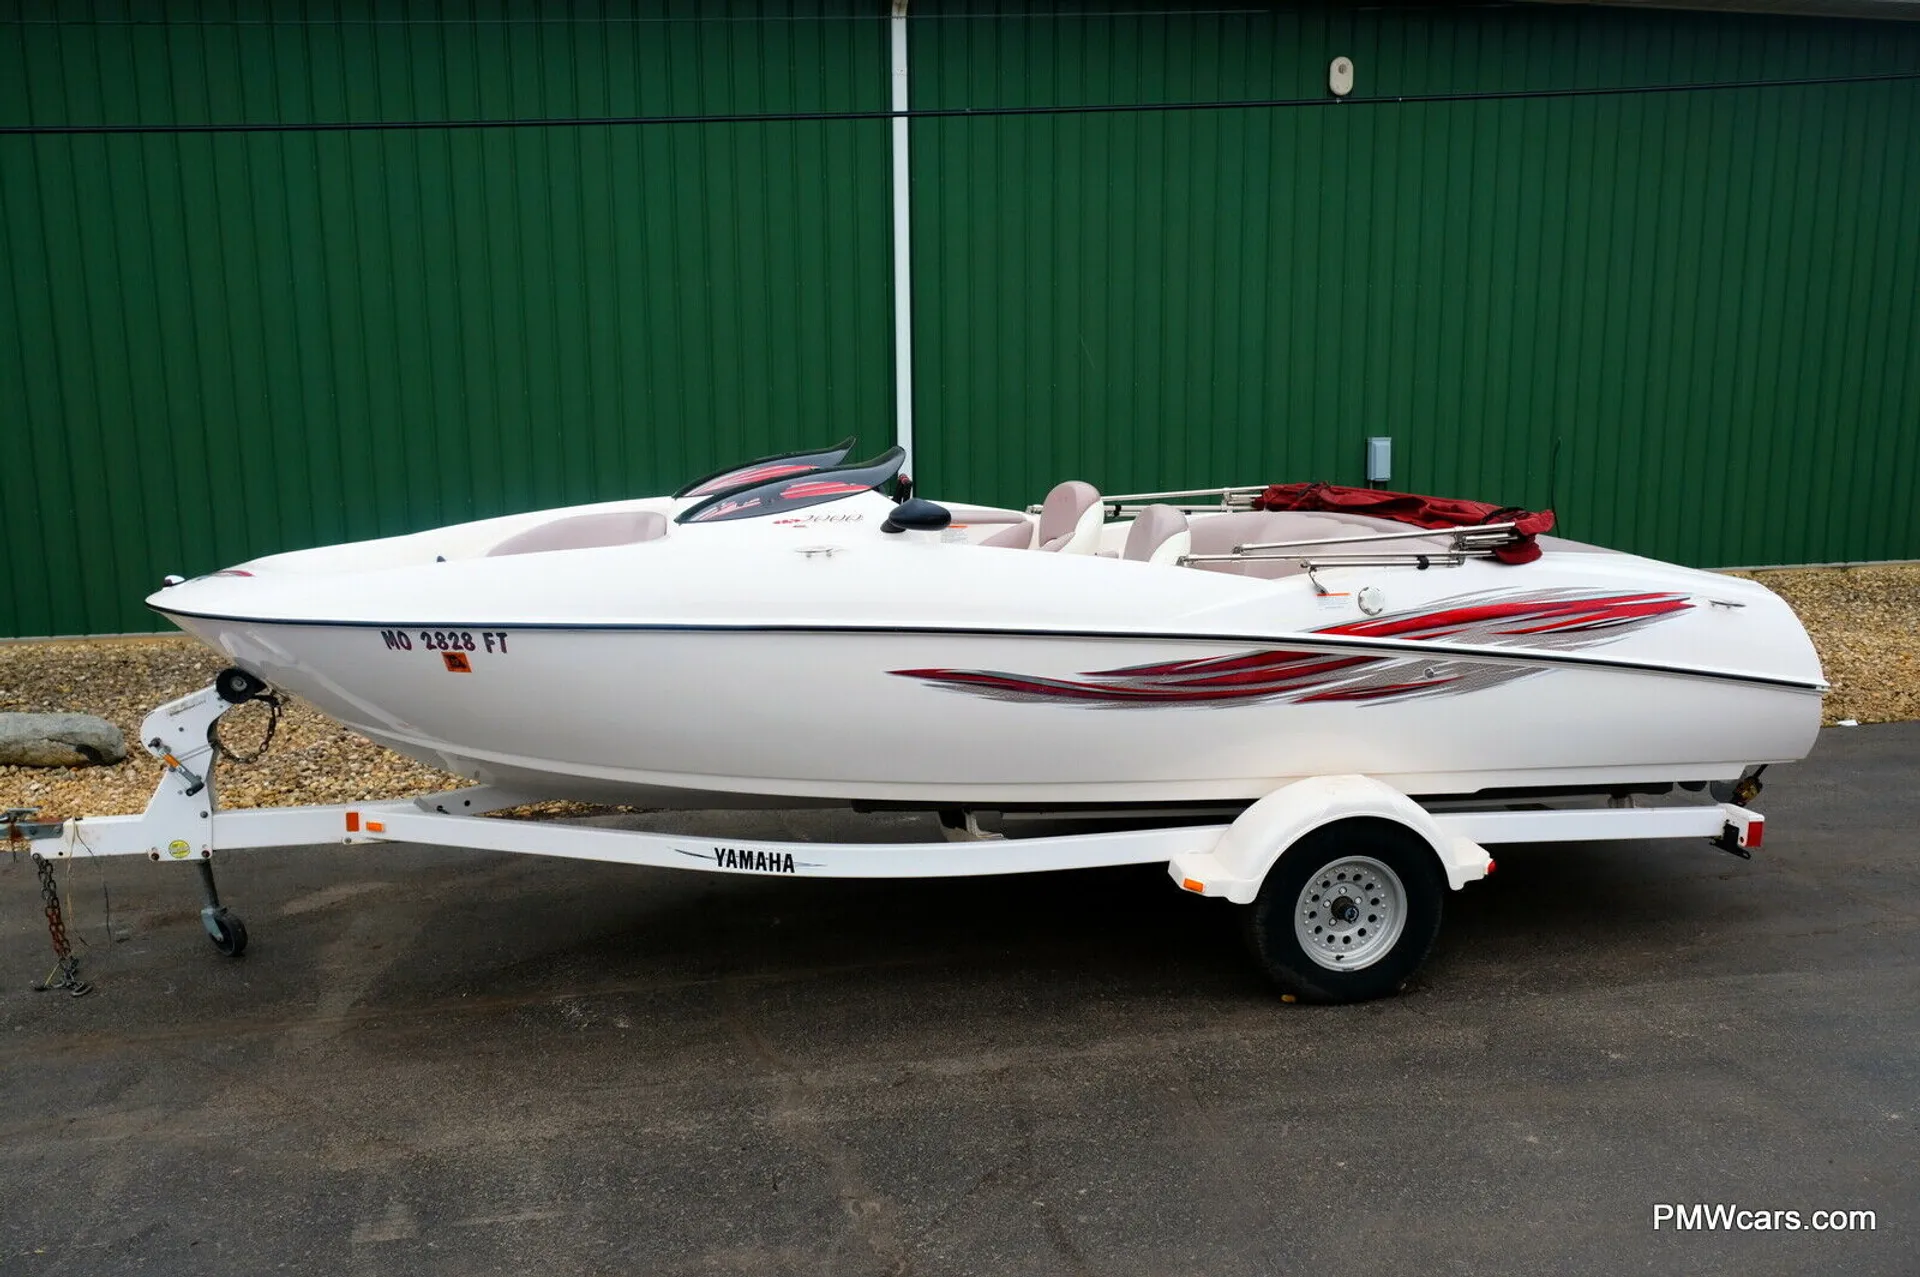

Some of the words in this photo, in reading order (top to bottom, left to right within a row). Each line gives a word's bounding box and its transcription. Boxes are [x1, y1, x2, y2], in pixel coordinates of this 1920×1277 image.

[381, 630, 412, 651] MO
[420, 631, 476, 652] 2828
[482, 632, 508, 653] FT
[714, 847, 795, 873] YAMAHA
